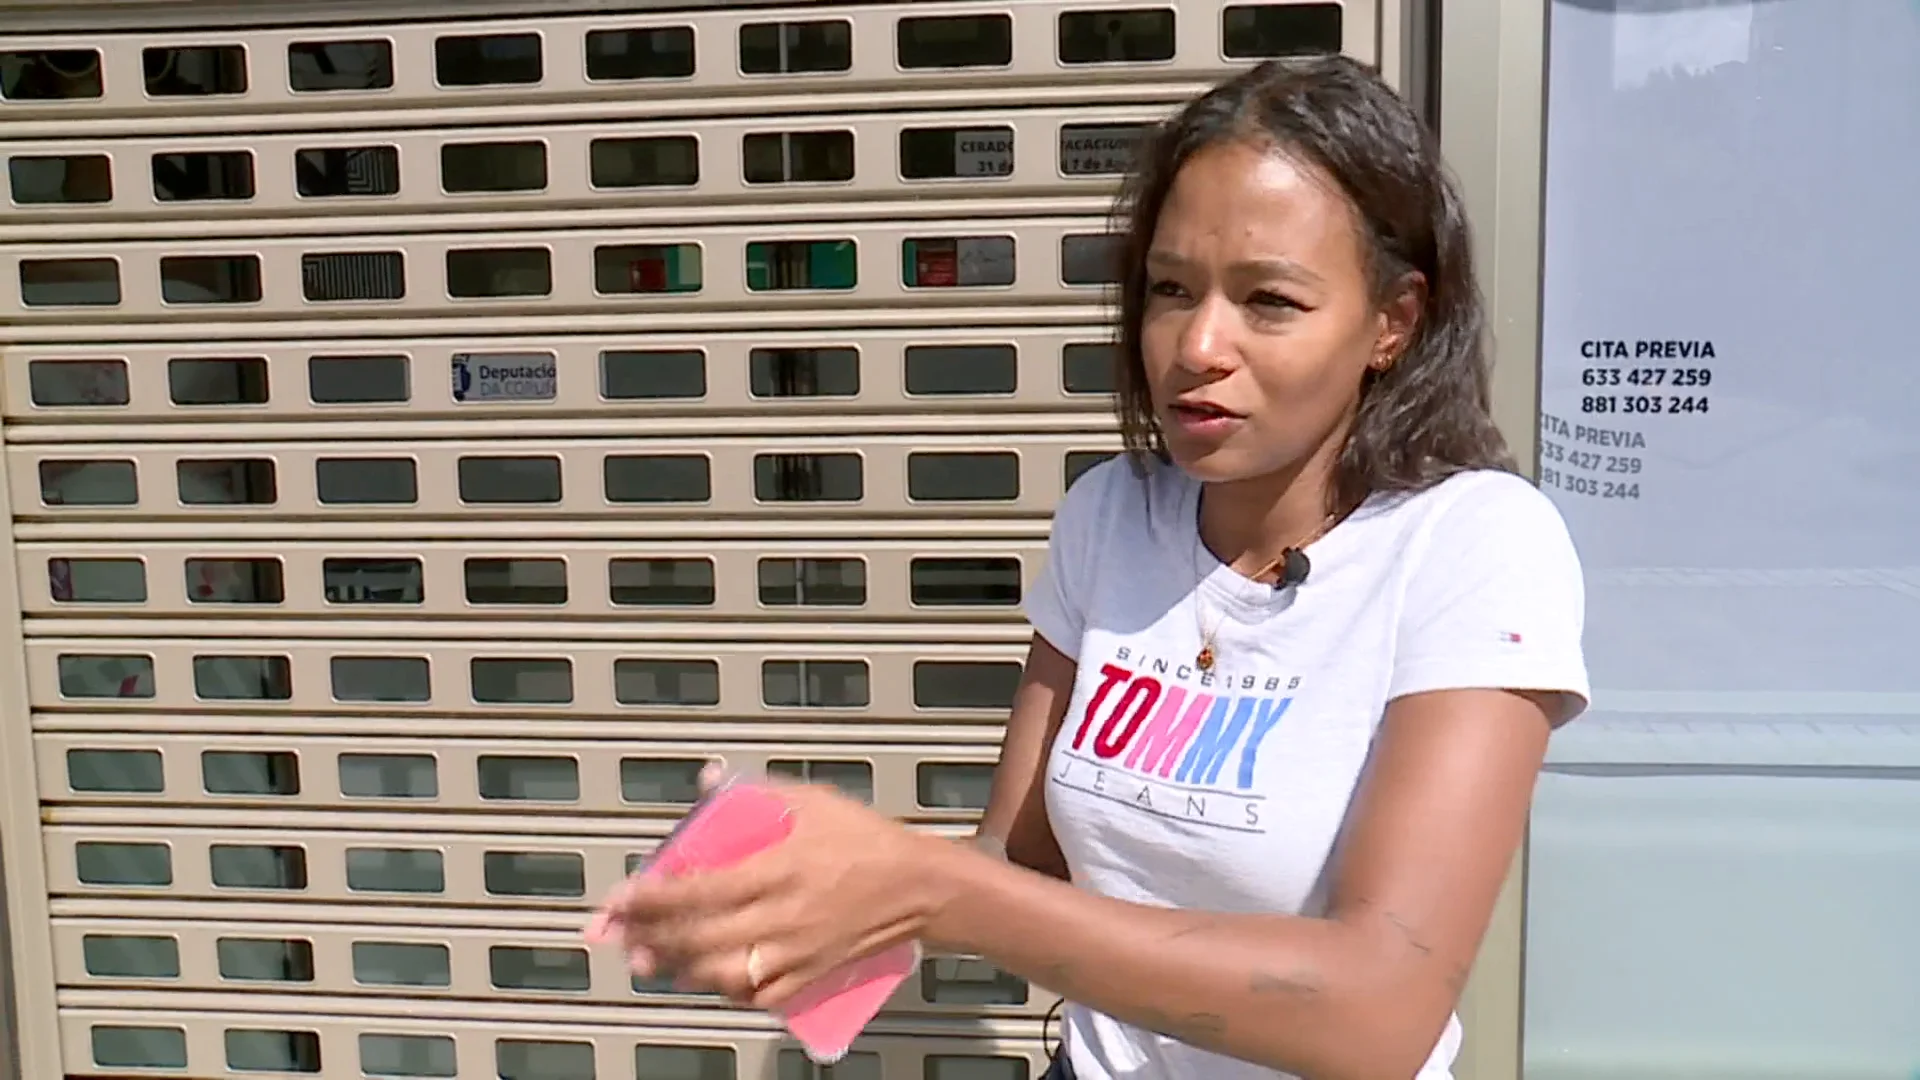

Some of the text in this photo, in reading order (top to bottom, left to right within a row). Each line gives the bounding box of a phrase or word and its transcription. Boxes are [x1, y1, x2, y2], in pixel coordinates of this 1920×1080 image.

[1580, 340, 1716, 359] CITA PREVIA
[1581, 368, 1712, 387] 633 427 259
[1581, 396, 1709, 414] 881 303 244
[1541, 413, 1646, 448] ITA PREVIA
[1541, 439, 1642, 475] 33 427 259
[1541, 466, 1640, 500] 81 303 244
[1116, 646, 1302, 693] SINCE 1985
[1071, 662, 1294, 789] TOMMY
[1058, 760, 1260, 826] JEANS
